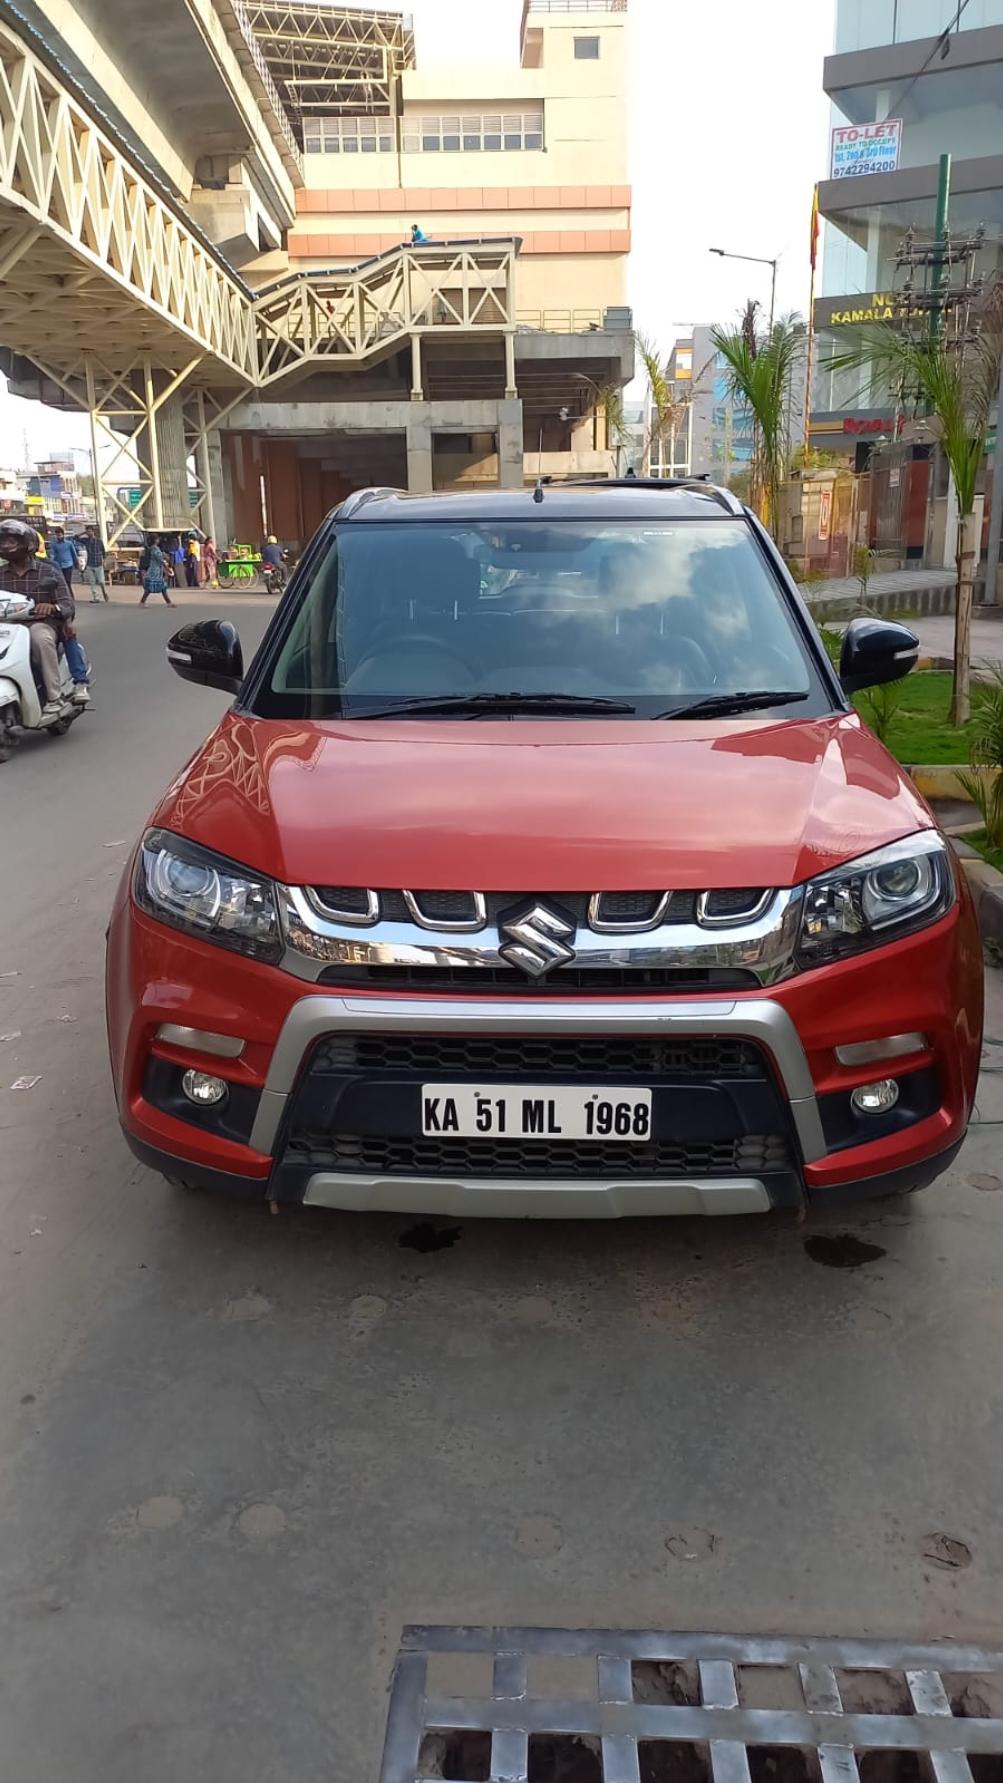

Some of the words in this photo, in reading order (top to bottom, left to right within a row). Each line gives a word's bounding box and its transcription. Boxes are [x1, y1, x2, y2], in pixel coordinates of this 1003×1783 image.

[836, 125, 897, 143] TO-LET
[833, 160, 896, 177] 9742294200
[831, 307, 893, 324] KAMALA
[424, 1098, 460, 1132] KA
[476, 1098, 506, 1133] 51
[522, 1099, 562, 1134] ML
[584, 1101, 649, 1136] 1968
